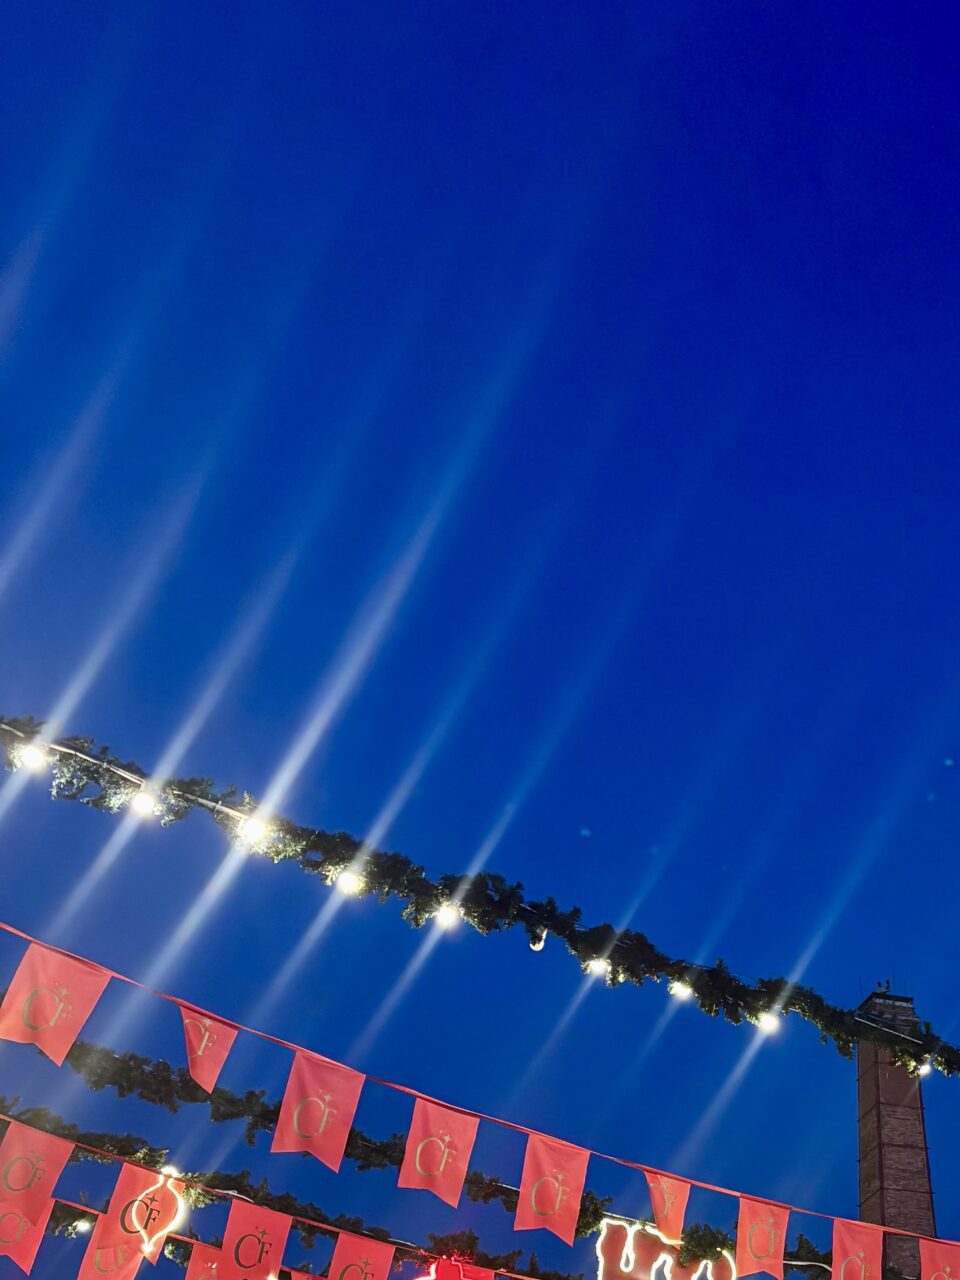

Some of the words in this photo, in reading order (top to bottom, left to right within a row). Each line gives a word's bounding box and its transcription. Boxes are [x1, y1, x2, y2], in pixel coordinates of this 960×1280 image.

[22, 987, 72, 1031] CF
[293, 1096, 337, 1138] CF
[2, 1156, 46, 1192] CF
[416, 1137, 456, 1177] CF
[531, 1177, 569, 1216] CF
[120, 1199, 160, 1235] CF
[234, 1234, 272, 1269] CF
[749, 1222, 780, 1260] CF
